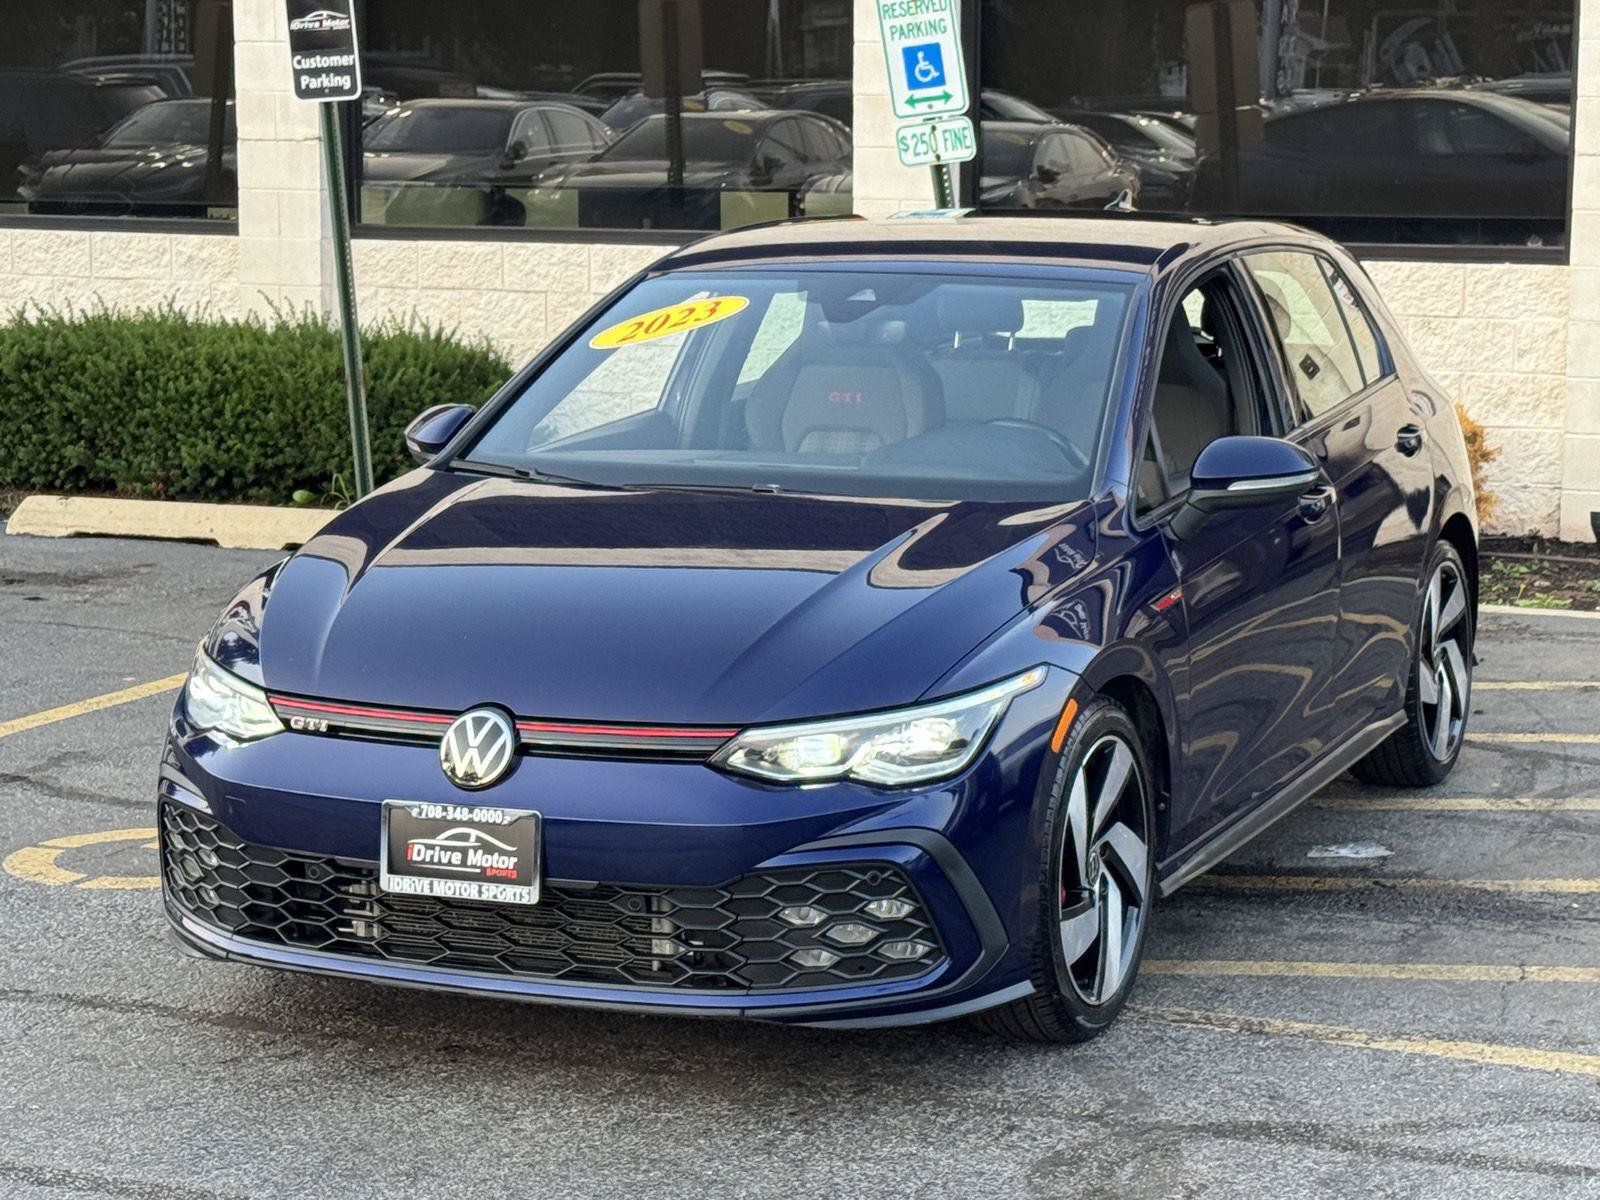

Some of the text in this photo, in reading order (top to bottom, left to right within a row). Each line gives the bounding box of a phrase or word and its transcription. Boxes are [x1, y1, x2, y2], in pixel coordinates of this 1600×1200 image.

[882, 0, 947, 20] RESERVED
[322, 18, 350, 27] Motor
[889, 18, 947, 41] PARKING
[293, 54, 355, 69] Customer
[301, 73, 351, 90] Parking
[900, 126, 972, 157] $250 FINE
[616, 301, 722, 343] 2023
[290, 715, 329, 733] GTI
[420, 804, 503, 824] 708-348-0000
[406, 842, 518, 870] iDrive Motor
[485, 868, 518, 879] SPORTS
[433, 880, 480, 898] MOTOR
[481, 885, 531, 902] SPORTS
